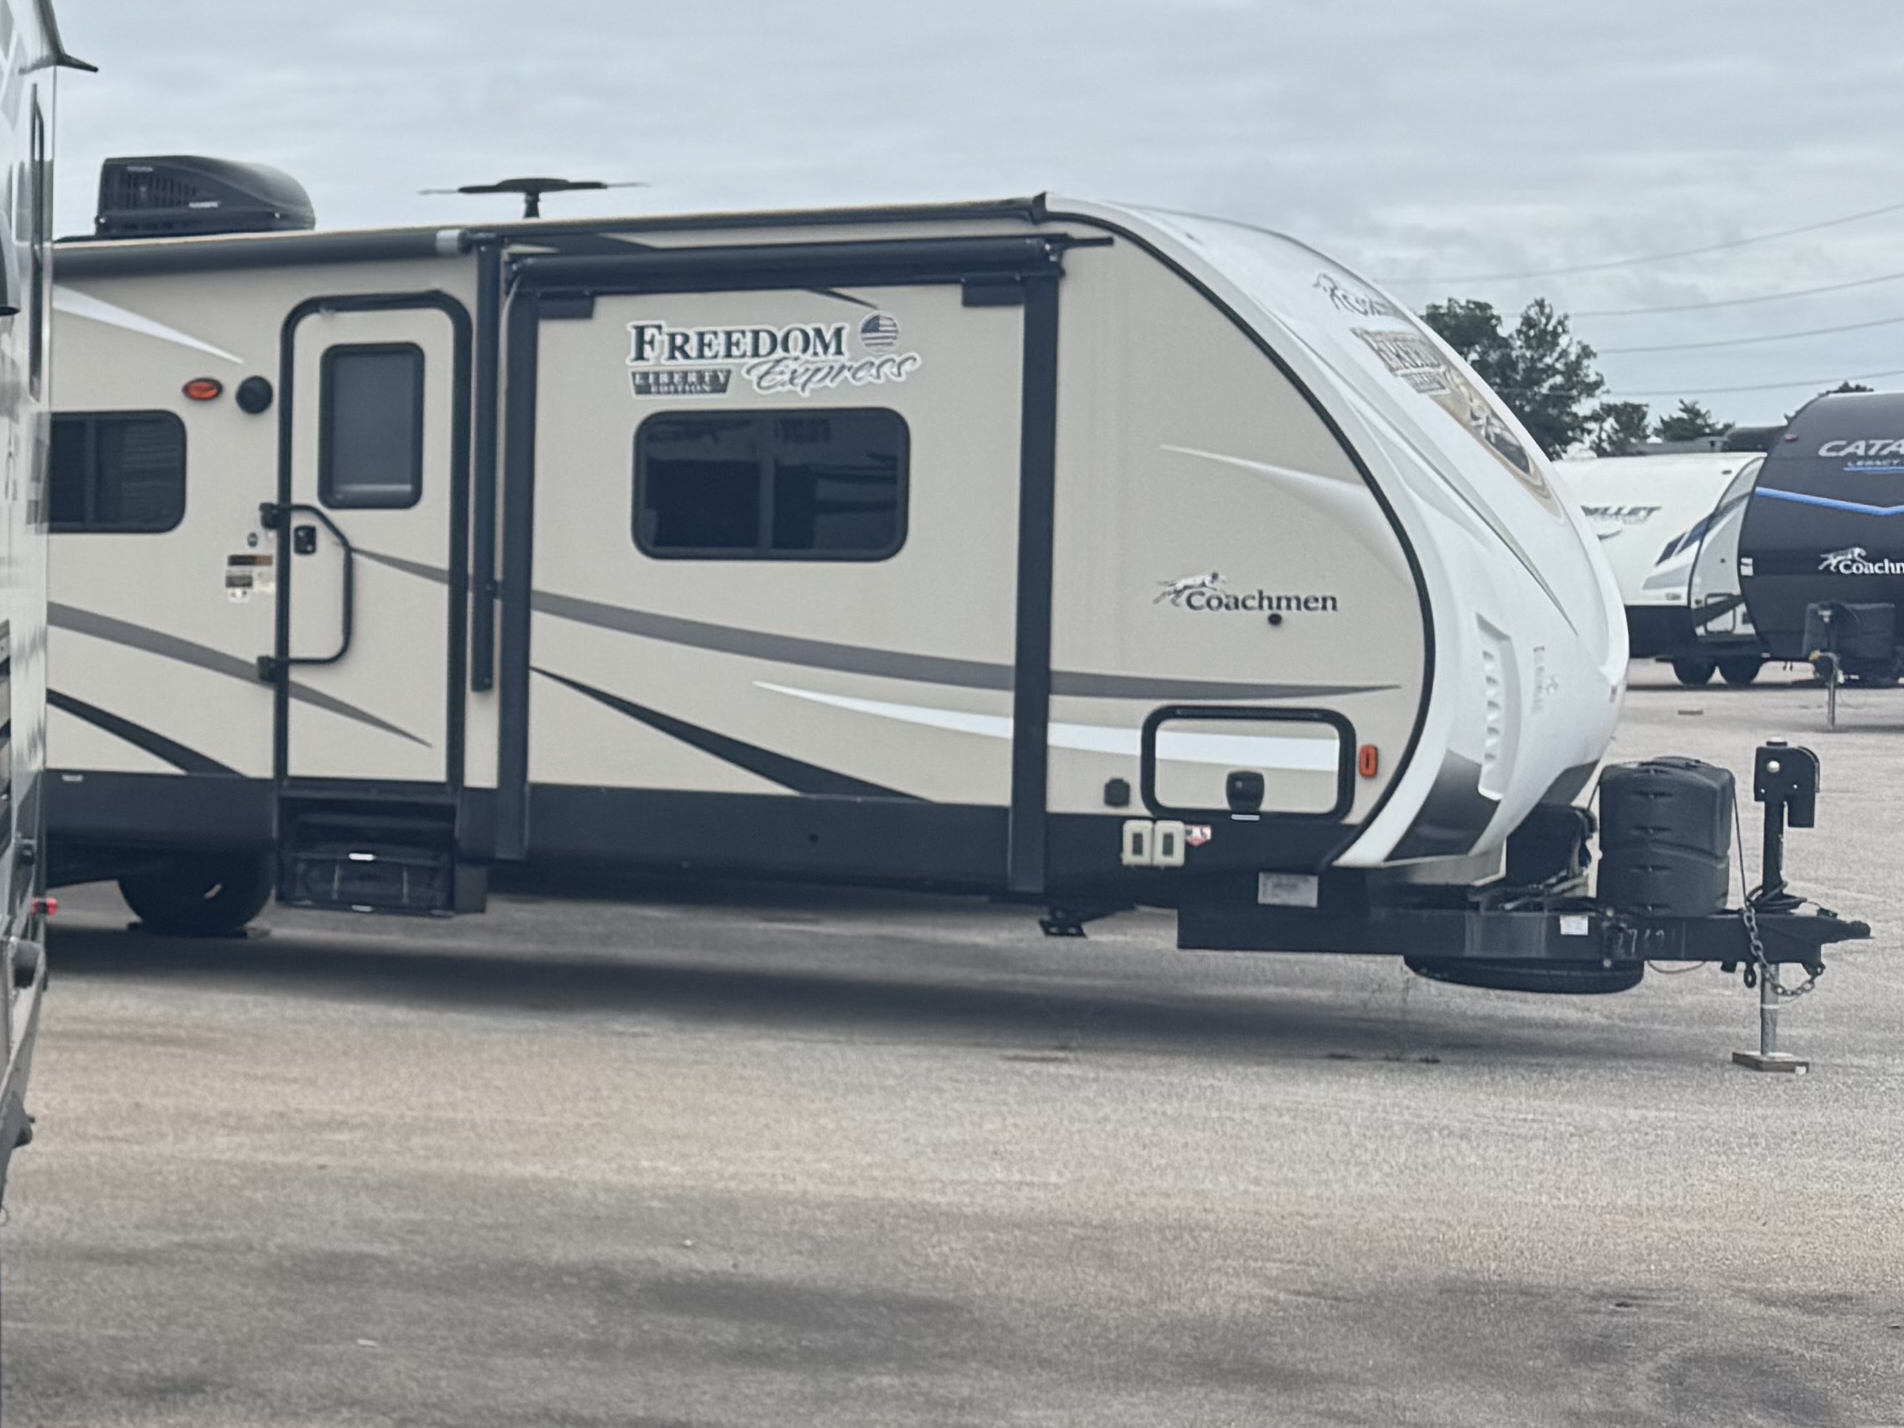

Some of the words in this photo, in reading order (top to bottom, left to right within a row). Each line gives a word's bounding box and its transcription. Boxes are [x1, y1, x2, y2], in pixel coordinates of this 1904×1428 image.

[630, 323, 848, 362] FREEDOM
[743, 353, 919, 393] Express
[1185, 589, 1339, 612] Coachmen
